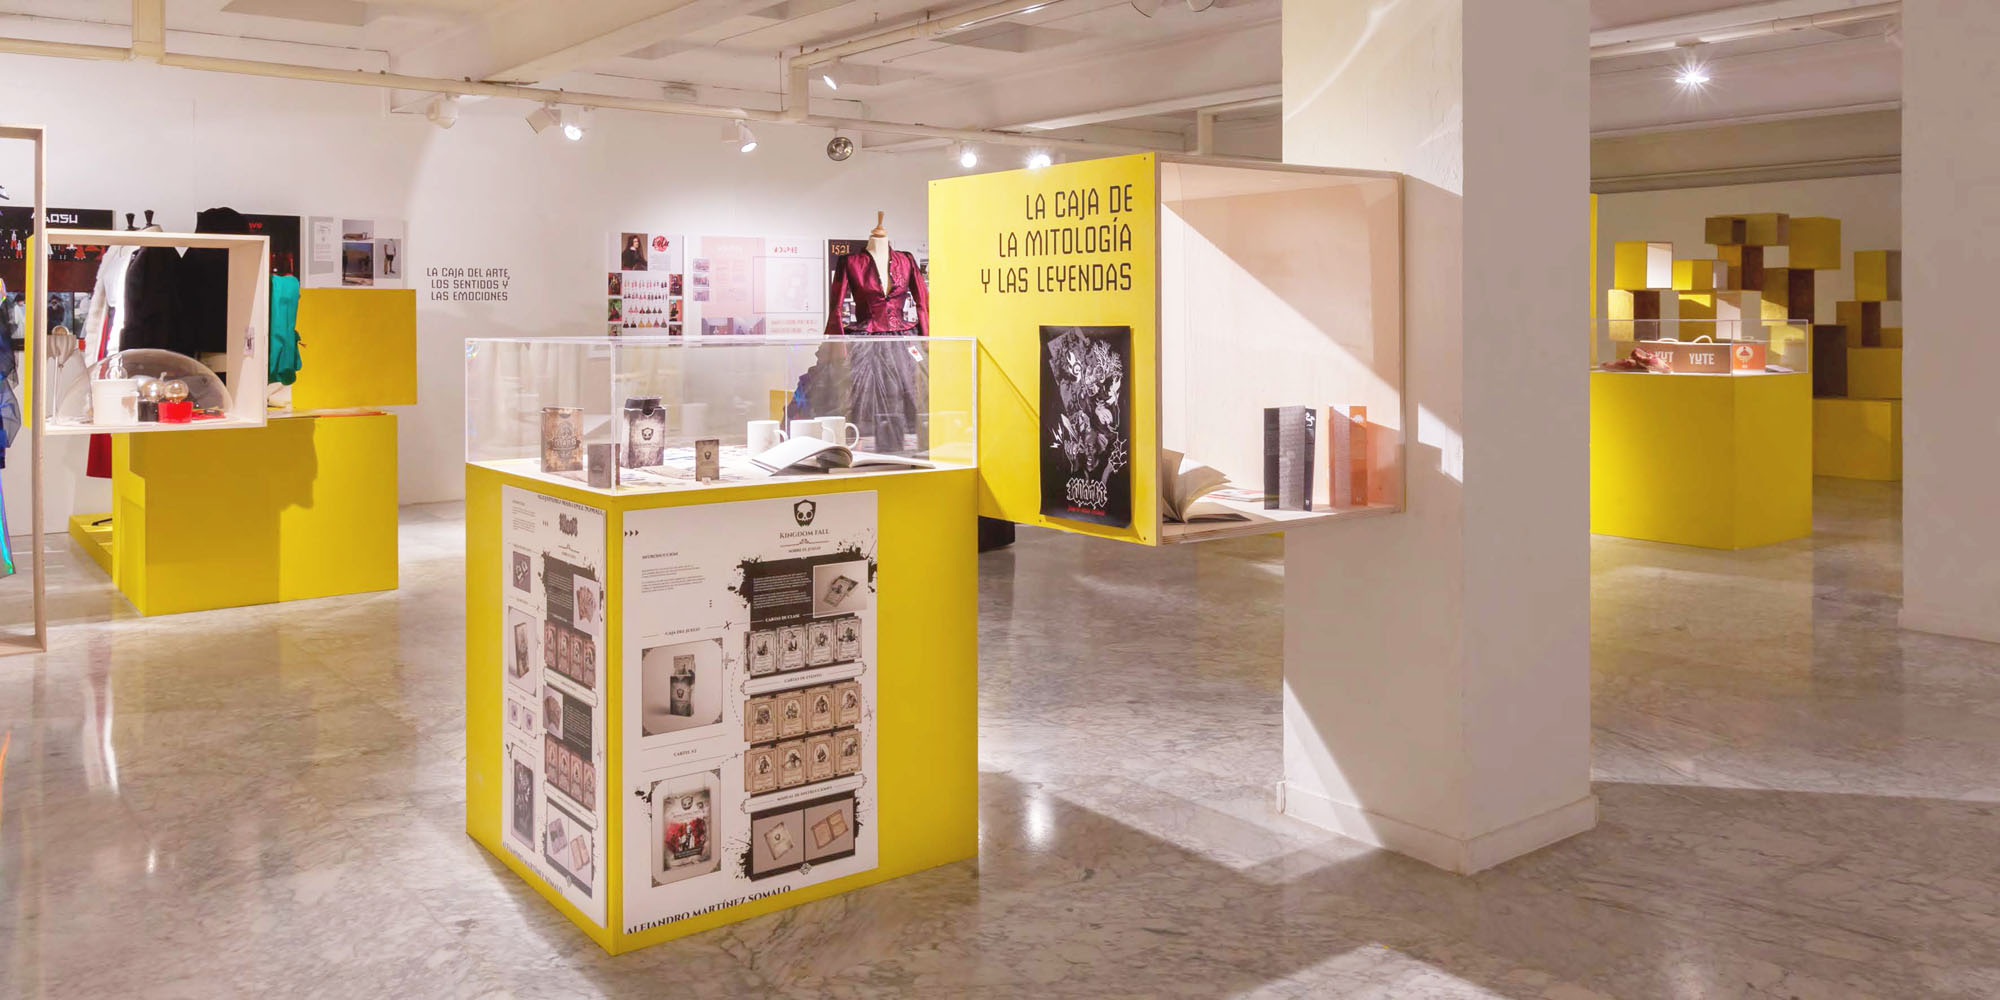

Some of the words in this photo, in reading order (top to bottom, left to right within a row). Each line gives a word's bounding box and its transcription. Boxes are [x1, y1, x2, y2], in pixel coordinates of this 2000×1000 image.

[1026, 193, 1046, 220] LA
[1055, 188, 1099, 220] CAJA
[1109, 184, 1133, 213] DE
[999, 231, 1018, 258] LA
[1025, 217, 1132, 257] MITOLOGÍA
[426, 267, 438, 277] LA
[441, 267, 464, 279] CAJA
[467, 267, 483, 278] DEL
[486, 268, 511, 280] ARTE,
[981, 268, 991, 294] Y
[998, 267, 1028, 293] LAS
[1037, 262, 1132, 292] LEYENDAS
[431, 279, 449, 289] LOS
[453, 279, 499, 289] SENTIDOS
[502, 280, 509, 289] Y
[431, 291, 449, 301] LAS
[453, 291, 508, 301] EMOCIONES
[1688, 352, 1716, 366] YUTE
